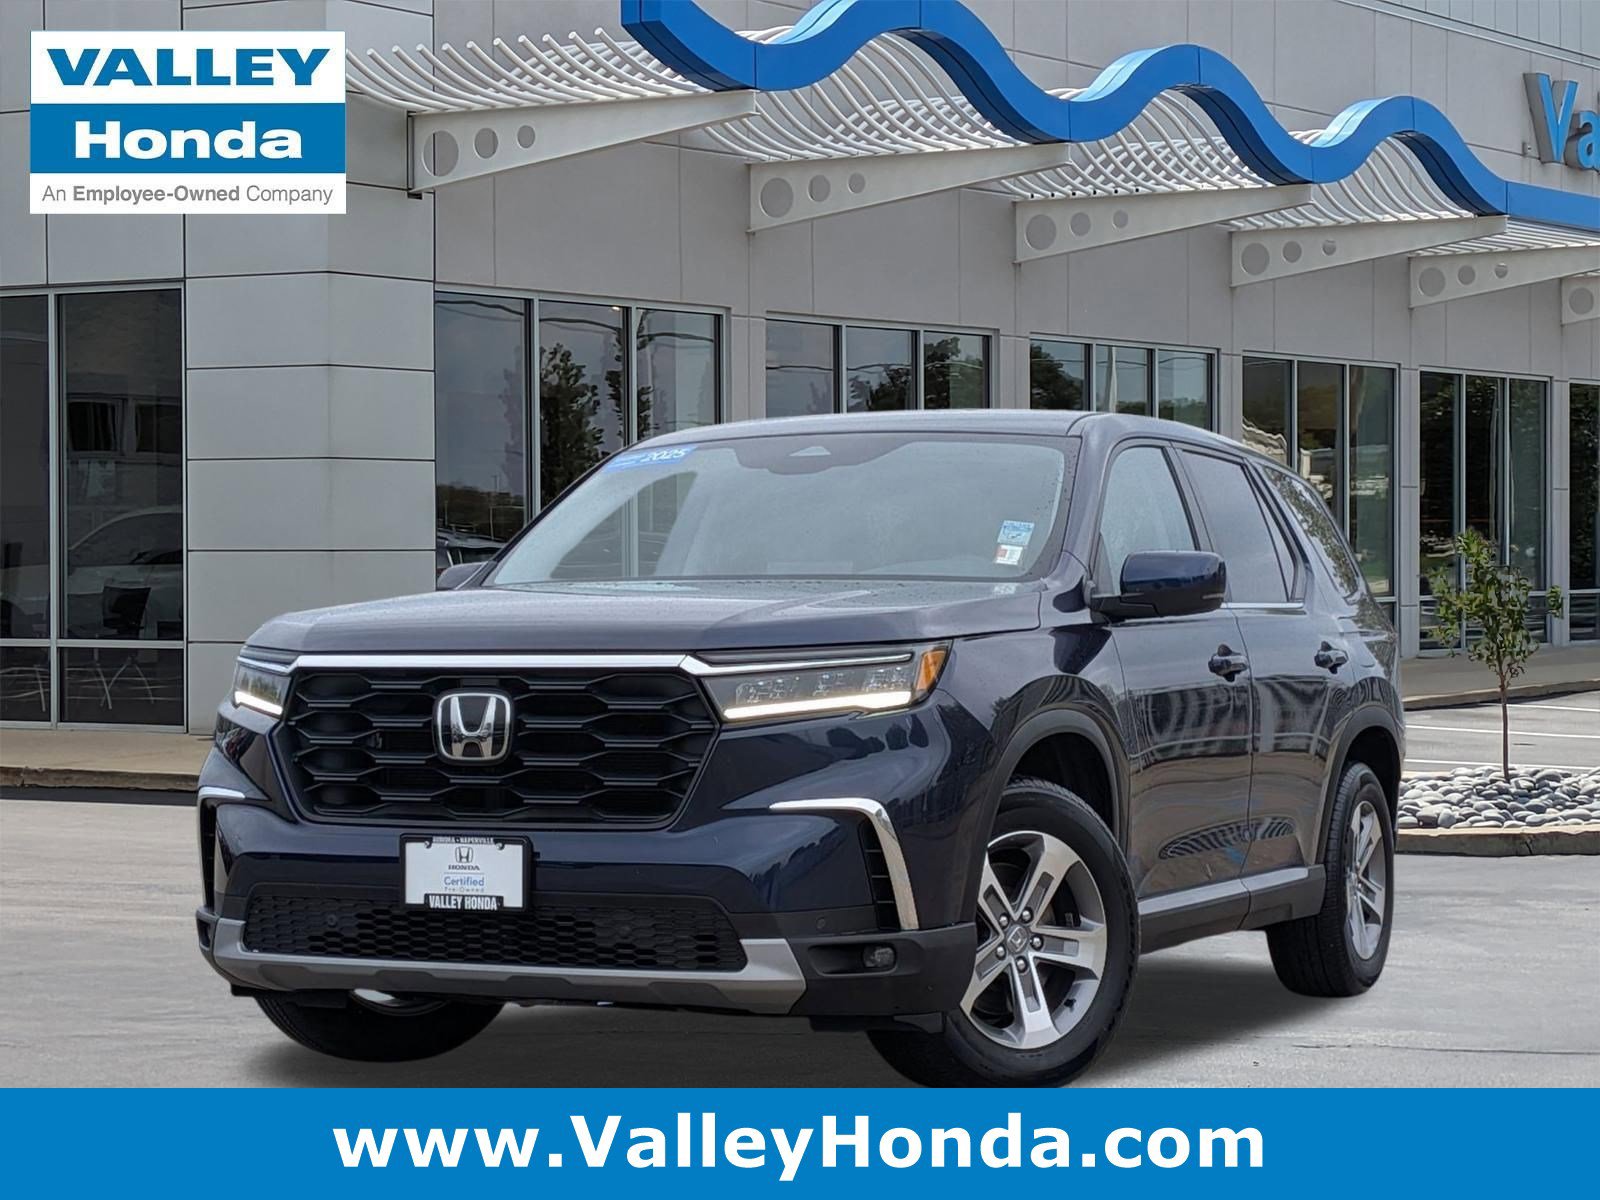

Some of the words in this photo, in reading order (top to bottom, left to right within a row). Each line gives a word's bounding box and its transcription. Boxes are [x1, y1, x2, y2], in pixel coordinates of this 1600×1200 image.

[443, 875, 485, 887] Certified
[428, 894, 462, 909] VALLEY
[464, 895, 498, 911] HONDA
